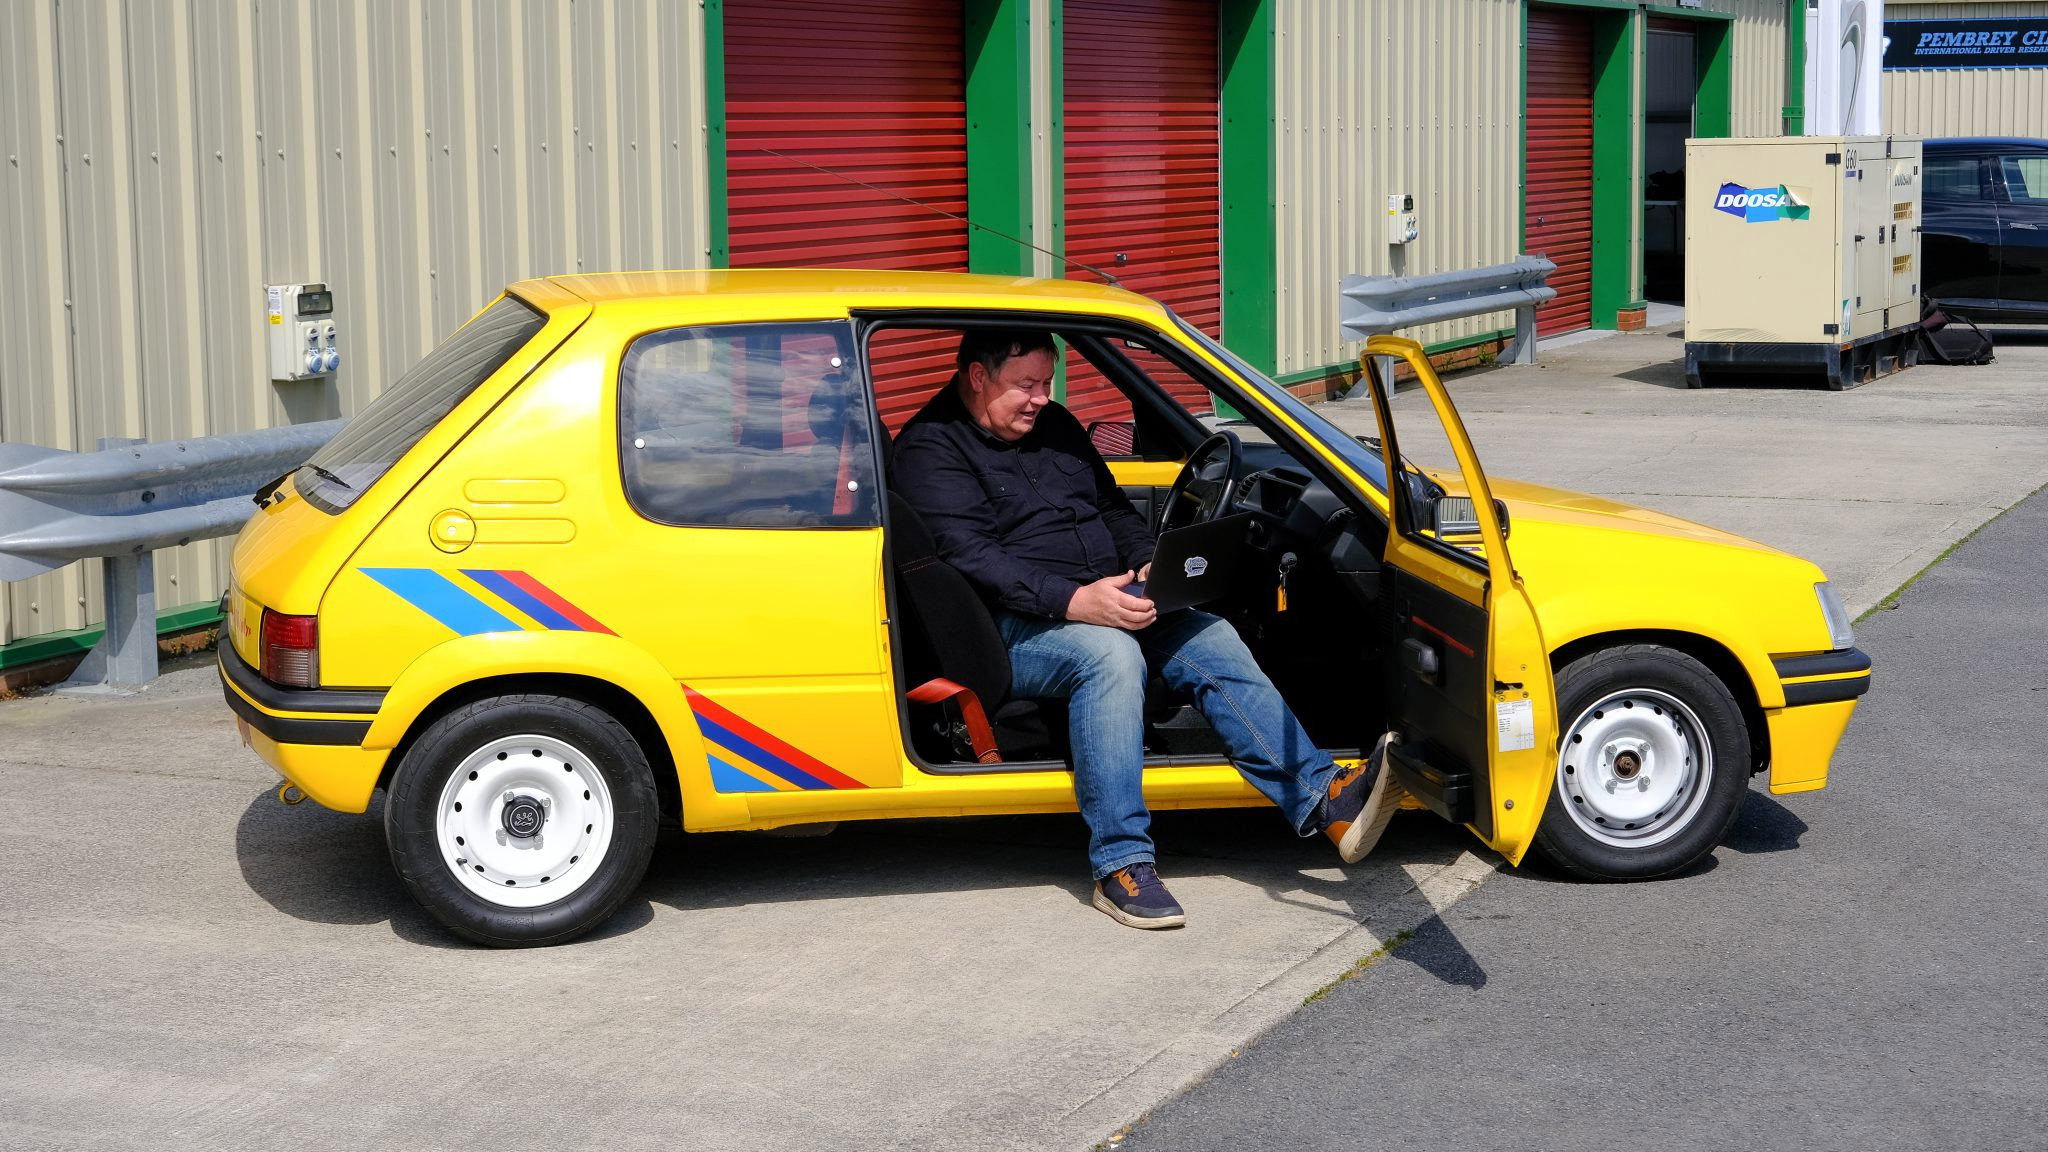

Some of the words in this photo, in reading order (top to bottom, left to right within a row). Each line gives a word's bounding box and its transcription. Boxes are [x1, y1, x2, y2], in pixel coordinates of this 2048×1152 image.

[1917, 31, 2018, 47] PEMBREY
[2022, 30, 2048, 46] CI
[1914, 47, 1982, 55] INTERNATIONAL
[1983, 46, 2016, 54] DRIVER
[1845, 148, 1858, 169] G60
[1717, 194, 1797, 208] DOOSA
